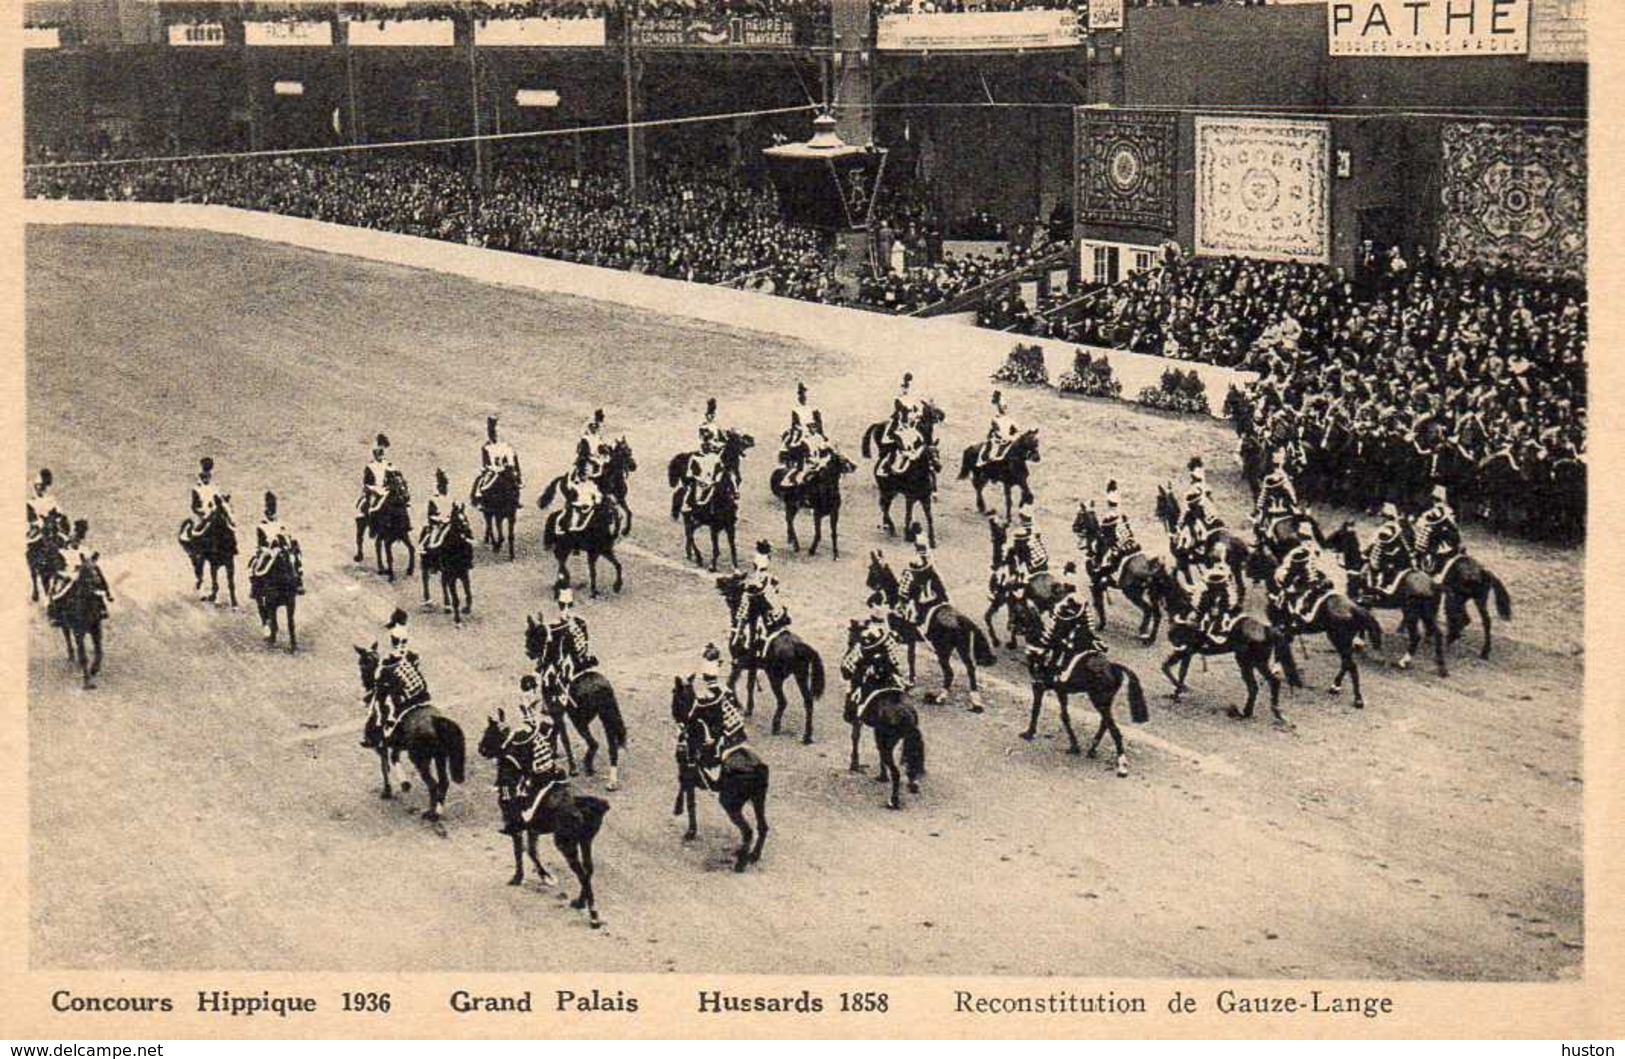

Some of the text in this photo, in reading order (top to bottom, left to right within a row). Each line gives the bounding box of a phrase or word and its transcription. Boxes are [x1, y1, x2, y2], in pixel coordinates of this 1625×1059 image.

[1333, 0, 1516, 36] PATHE
[52, 989, 1393, 1018] Concours Hippique 1936 Grand Palais Hussards 1858 Reconstitution de Gauze-Lange
